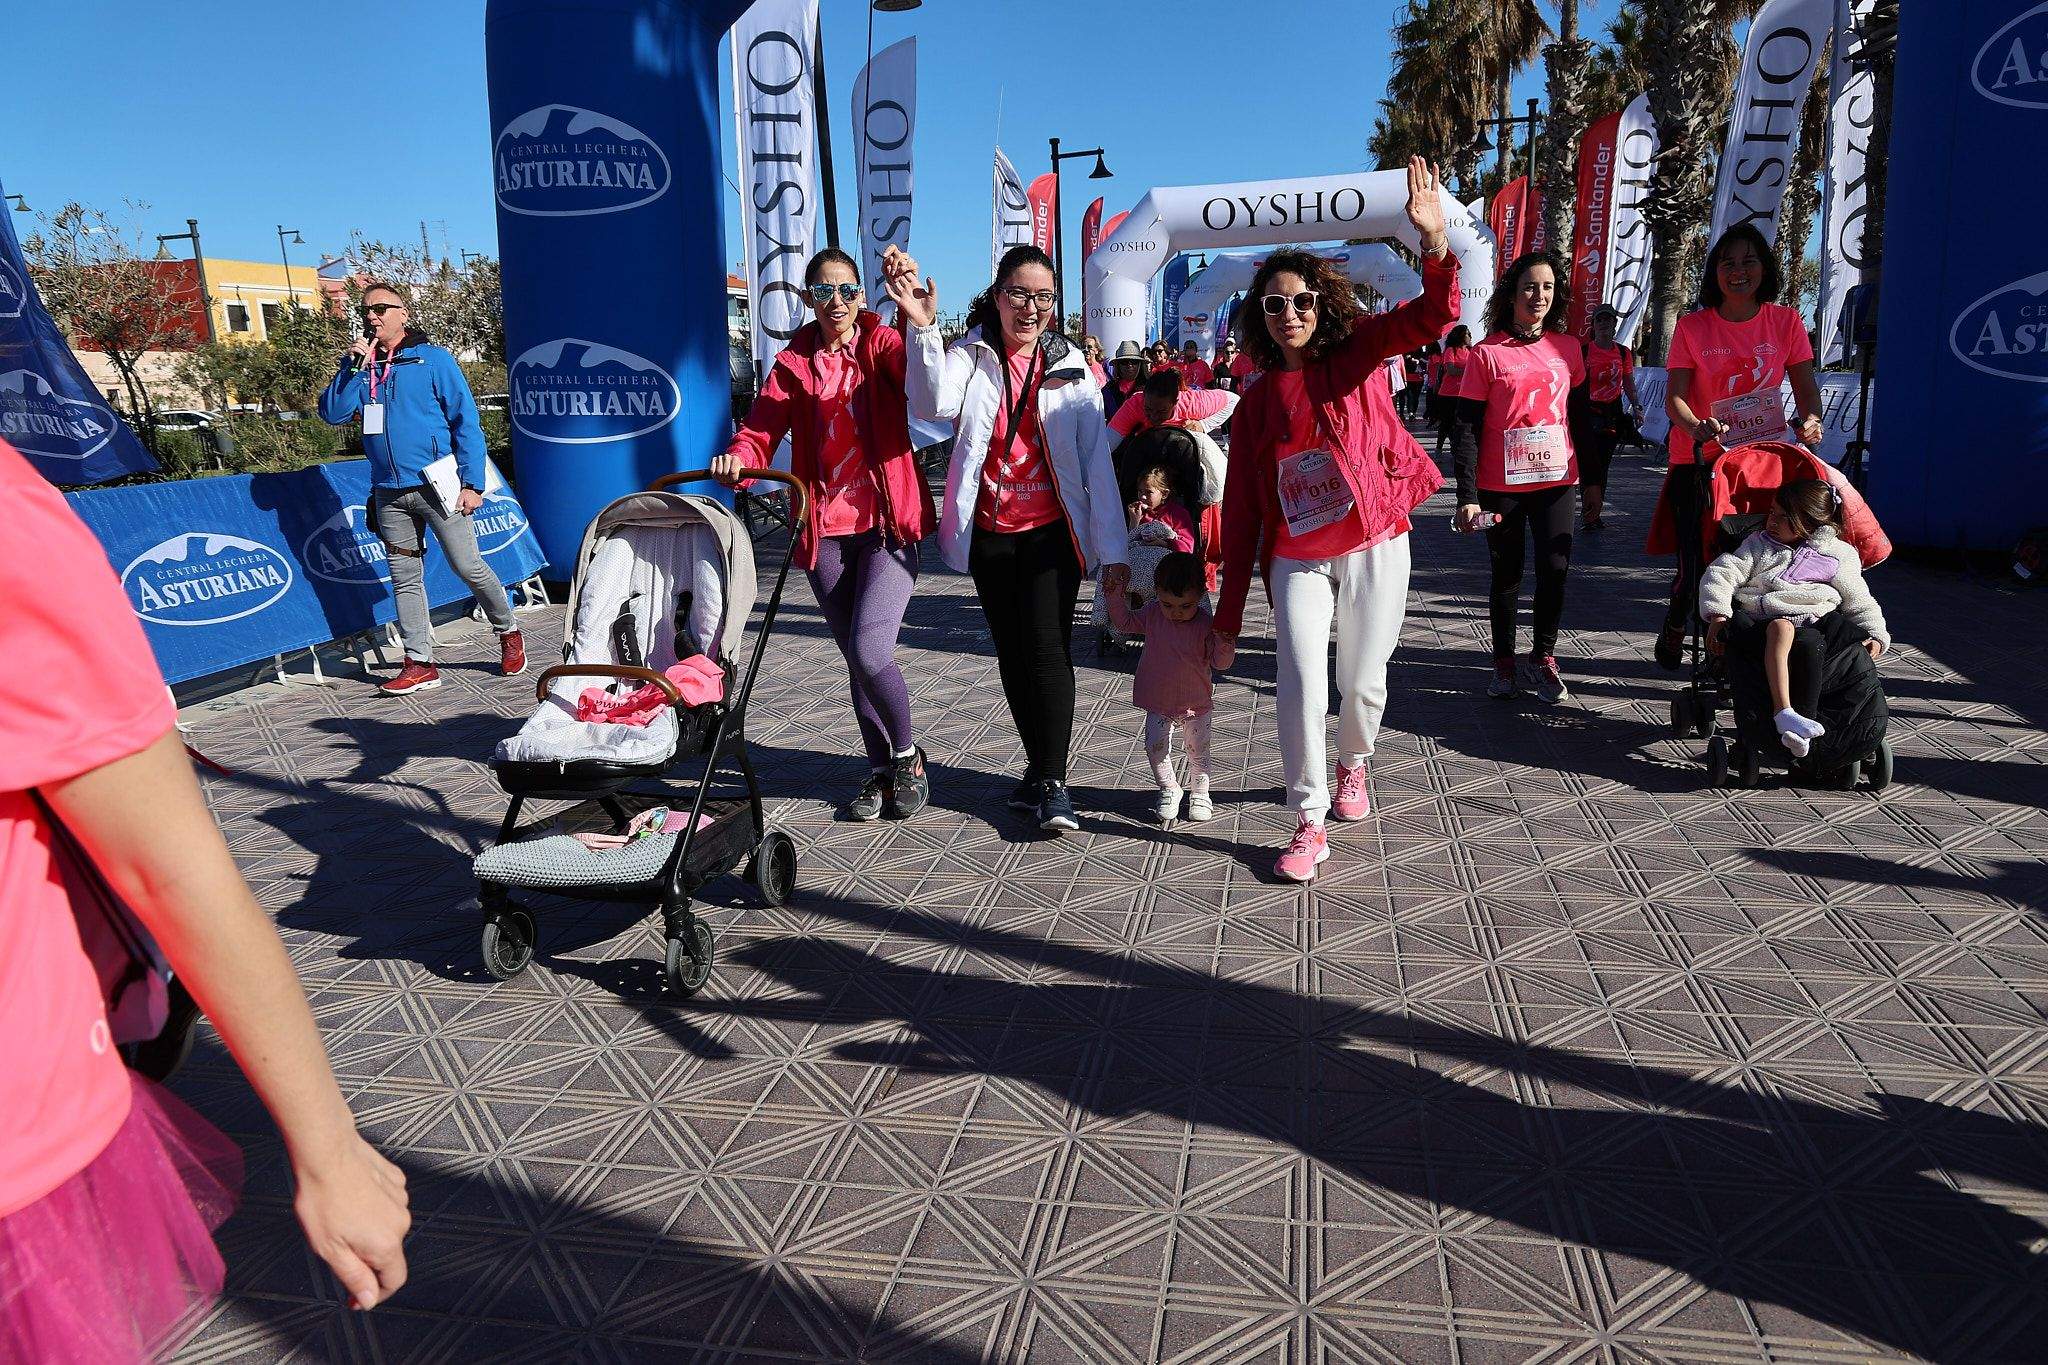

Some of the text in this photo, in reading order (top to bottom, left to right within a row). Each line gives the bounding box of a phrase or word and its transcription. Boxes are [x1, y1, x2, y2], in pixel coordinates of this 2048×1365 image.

[510, 143, 648, 158] CENTRAL LECHERA
[498, 152, 657, 193] ASTURIANA
[747, 30, 805, 341] OYSHO
[1584, 142, 1612, 247] Santander
[1202, 187, 1366, 231] OYSHO
[1611, 128, 1654, 319] OYSHO
[1109, 240, 1156, 253] OYSHO
[1090, 306, 1133, 318] OYSHO
[525, 375, 659, 386] CENTRAL LECHERA
[513, 377, 667, 416] ASTURIANA
[1738, 415, 1764, 430] 016
[1527, 450, 1551, 462] 016
[1308, 477, 1340, 498] 016
[1298, 515, 1325, 530] OYSHO
[156, 552, 270, 580] CENTRAL LECHERA
[138, 563, 286, 613] ASTURIANA
